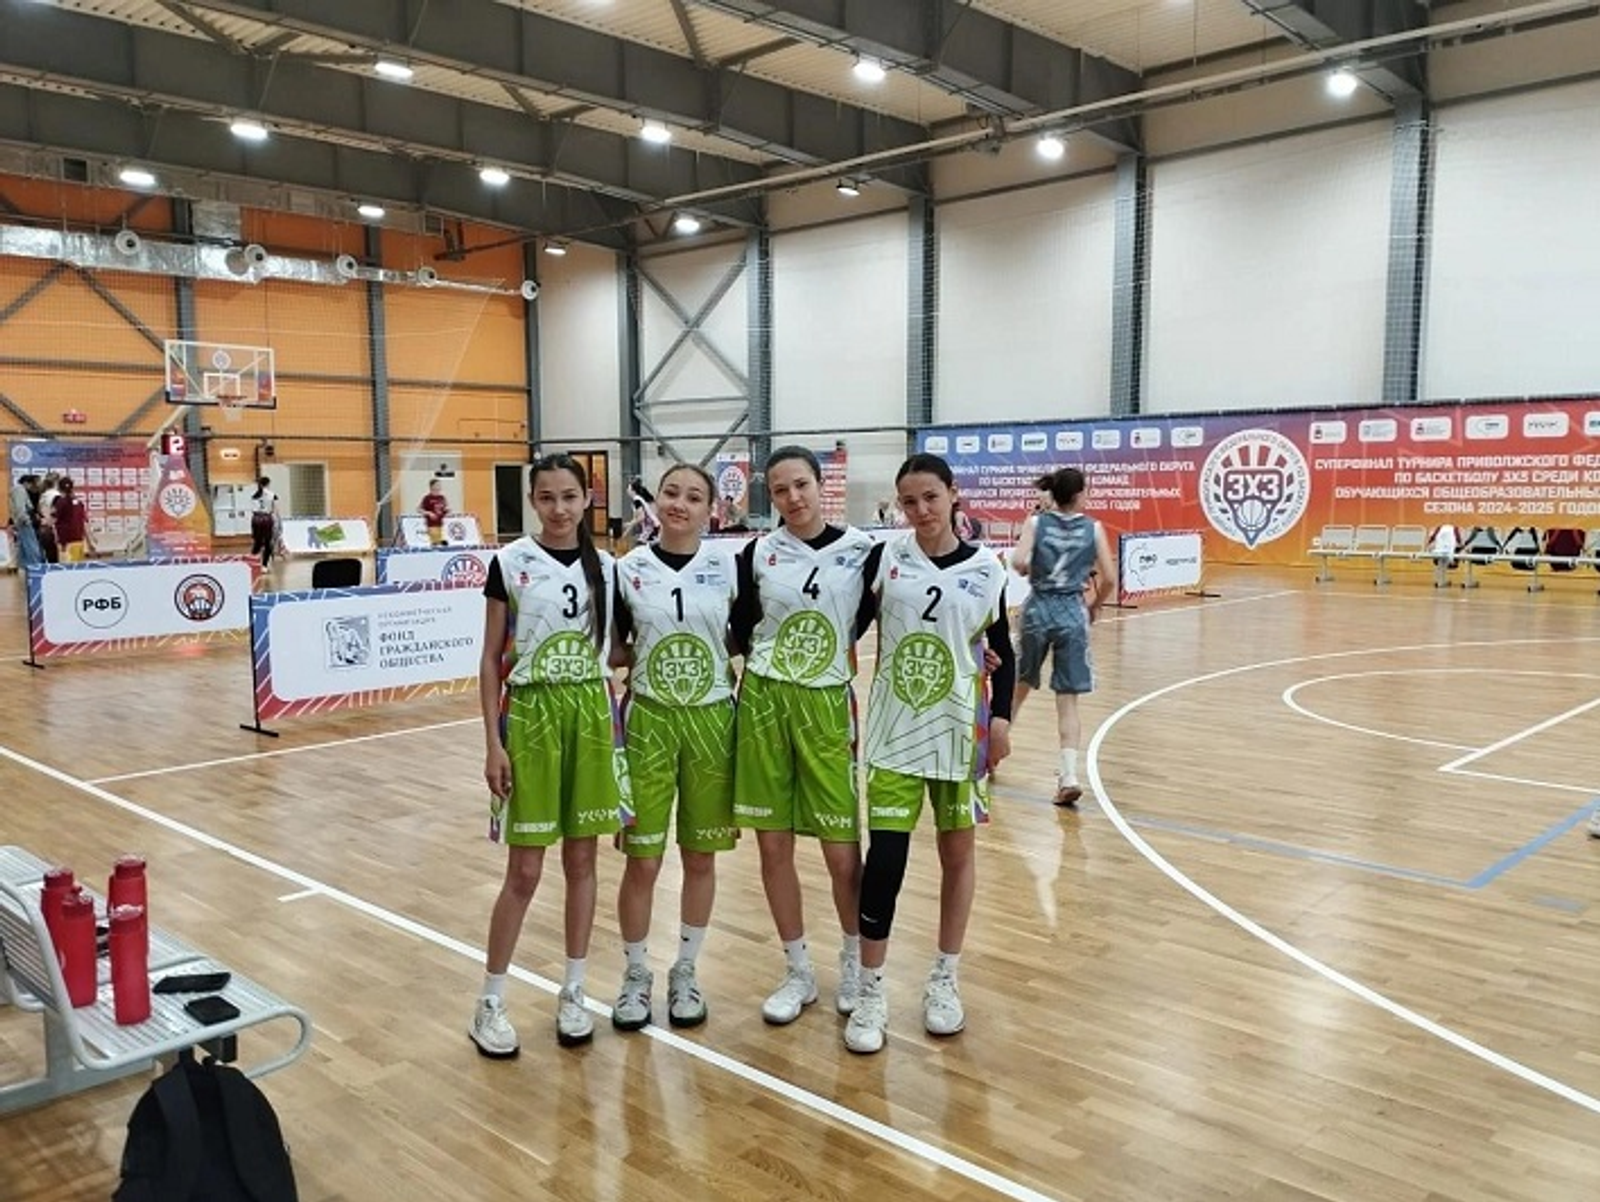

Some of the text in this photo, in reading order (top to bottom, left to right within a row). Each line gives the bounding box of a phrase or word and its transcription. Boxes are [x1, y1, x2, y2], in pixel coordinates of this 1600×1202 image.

[1398, 457, 1453, 468] ТУРНИРА
[1457, 455, 1568, 467] ПРИВОЛЖСКОГО
[1394, 472, 1411, 482] ПО
[1415, 472, 1498, 482] БАСКЕТБОЛУ
[1532, 470, 1578, 483] СРЕДИ
[1336, 487, 1429, 499] ОБУЧАЮЩИХСЯ
[1424, 503, 1475, 513] СЕЗОНА
[1478, 502, 1554, 513] 2024-2025
[802, 566, 819, 600] 4
[83, 597, 121, 611] РФБ
[562, 584, 578, 619] 3
[671, 587, 684, 622] 1
[922, 585, 942, 622] 2
[379, 631, 415, 643] ФОНД
[380, 637, 474, 656] ГРАЖДАНСКОГО
[379, 653, 444, 668] ОБЩЕСТВА
